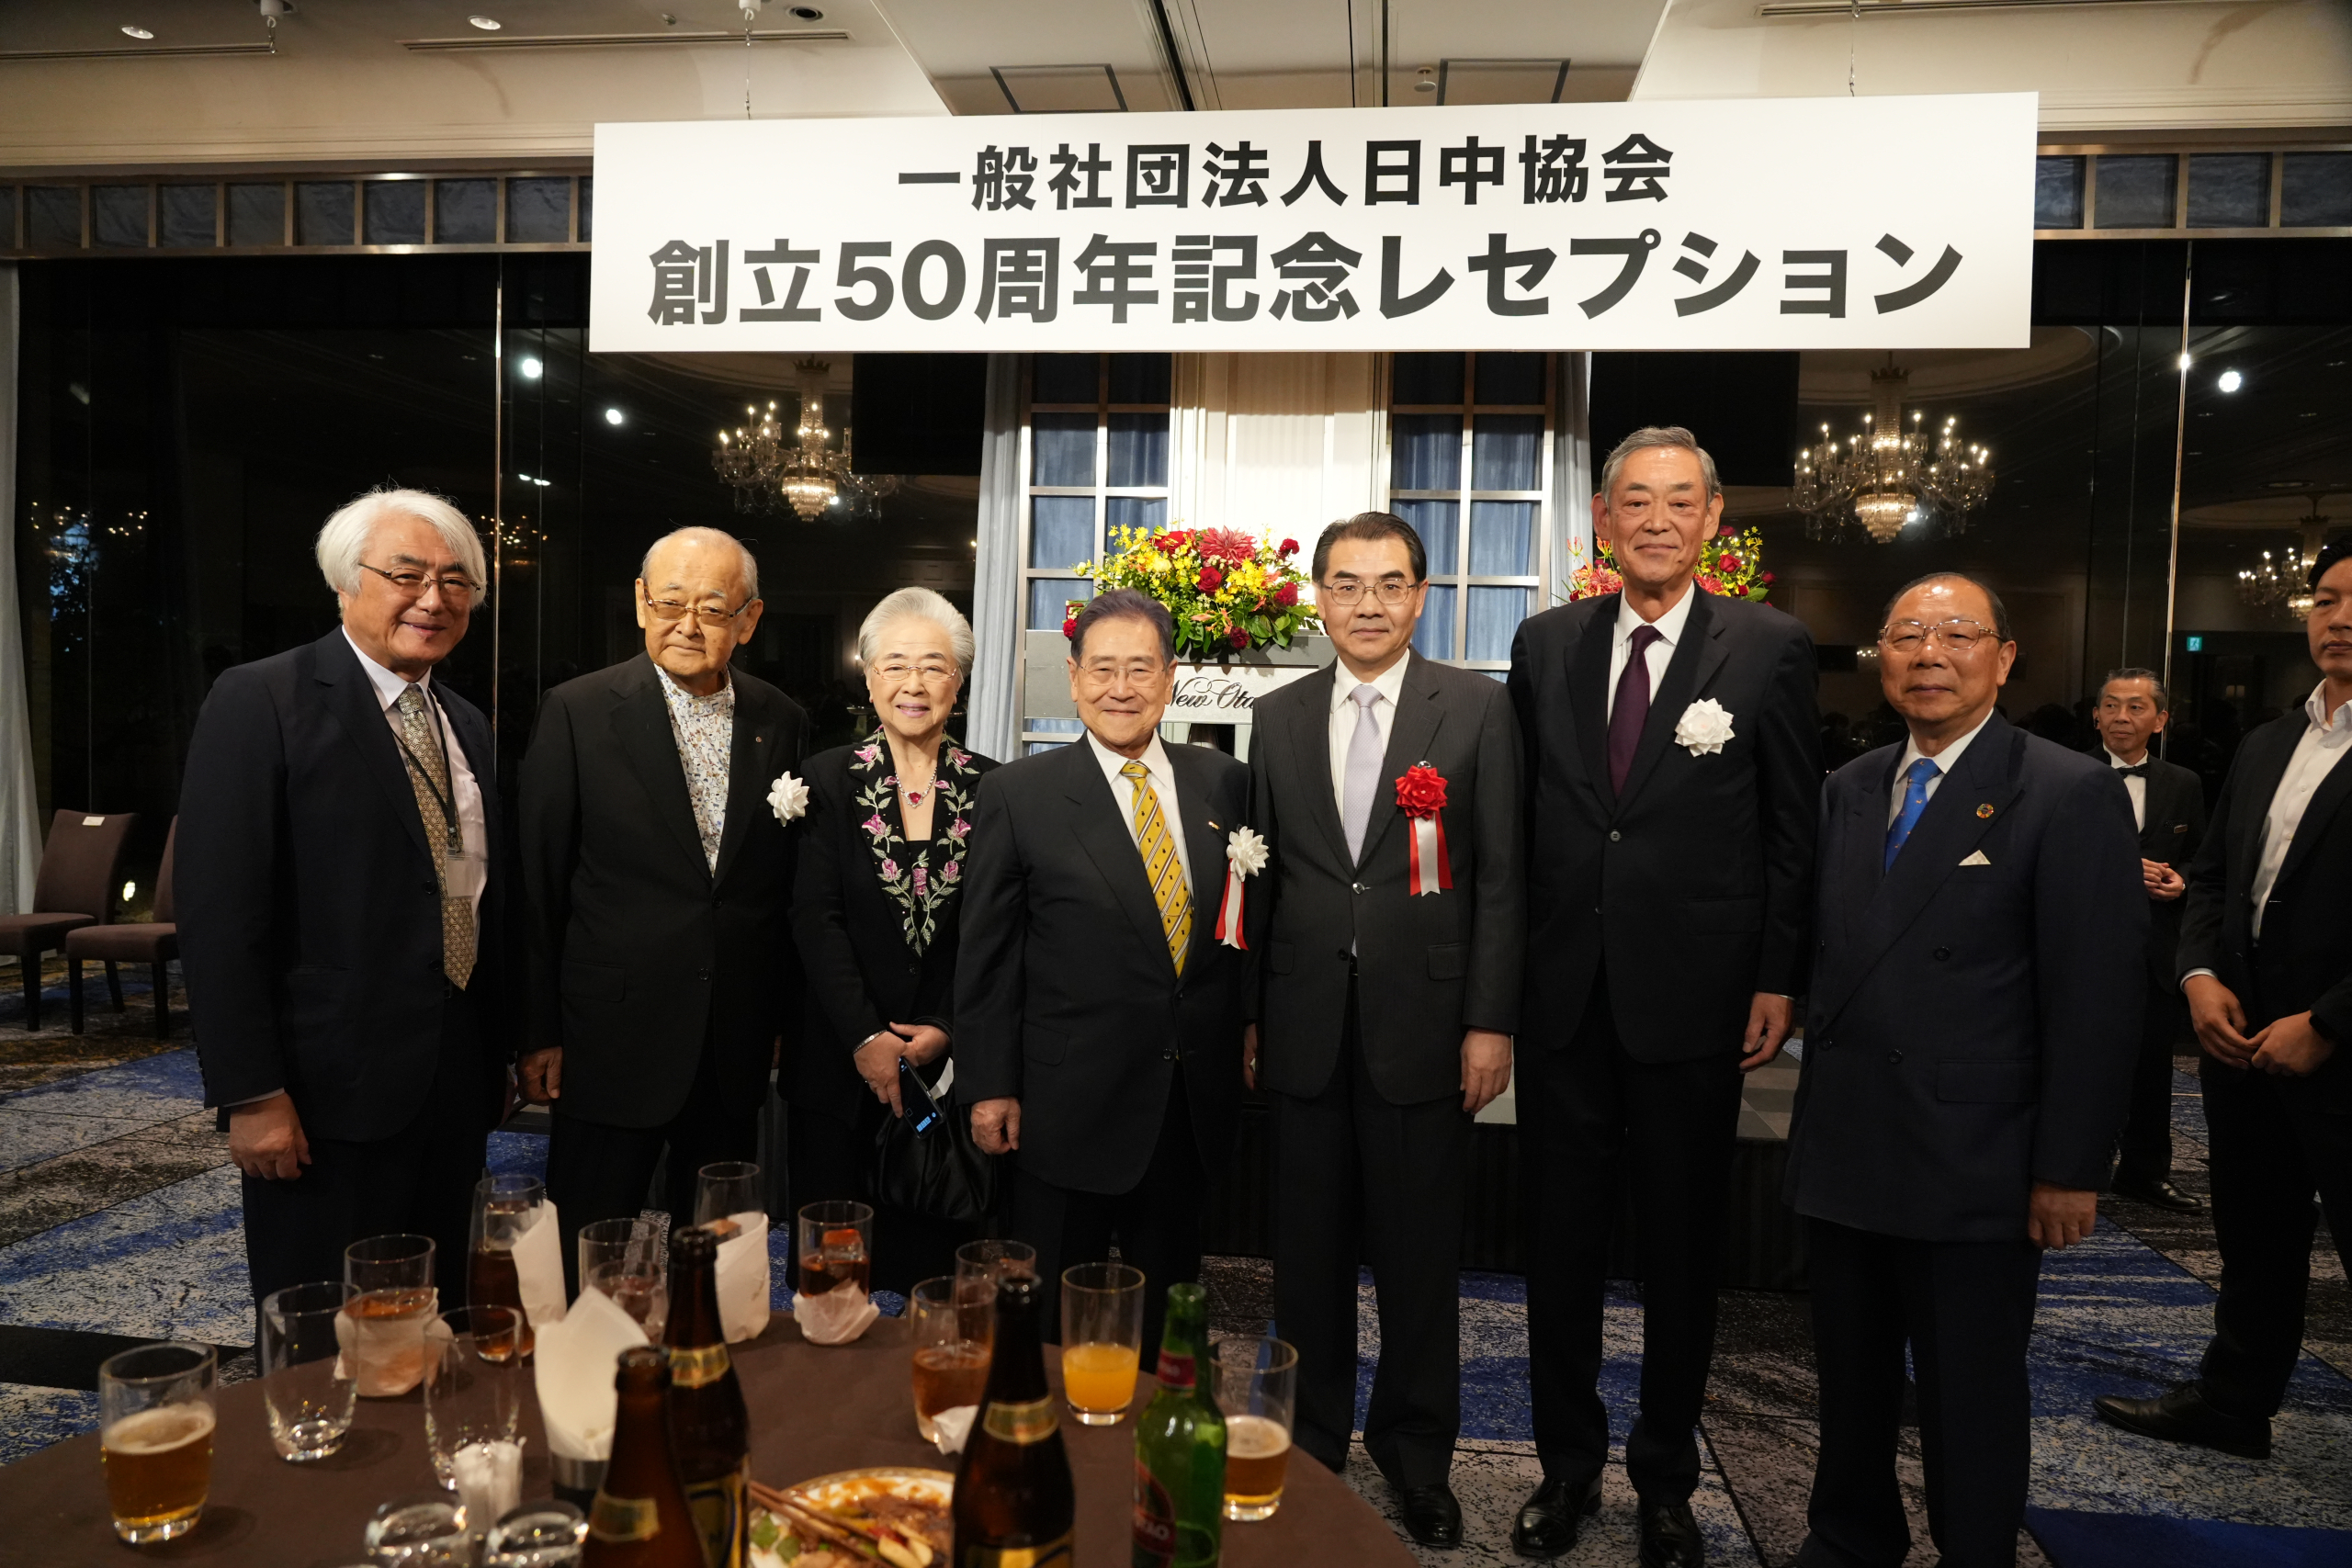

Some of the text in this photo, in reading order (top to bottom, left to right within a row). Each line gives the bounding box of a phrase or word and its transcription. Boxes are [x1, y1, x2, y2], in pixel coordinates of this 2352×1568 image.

[899, 134, 1673, 211] 一般社団法人日中協会
[649, 229, 1963, 326] 創立50周年記念レセプション
[1170, 677, 1213, 708] New
